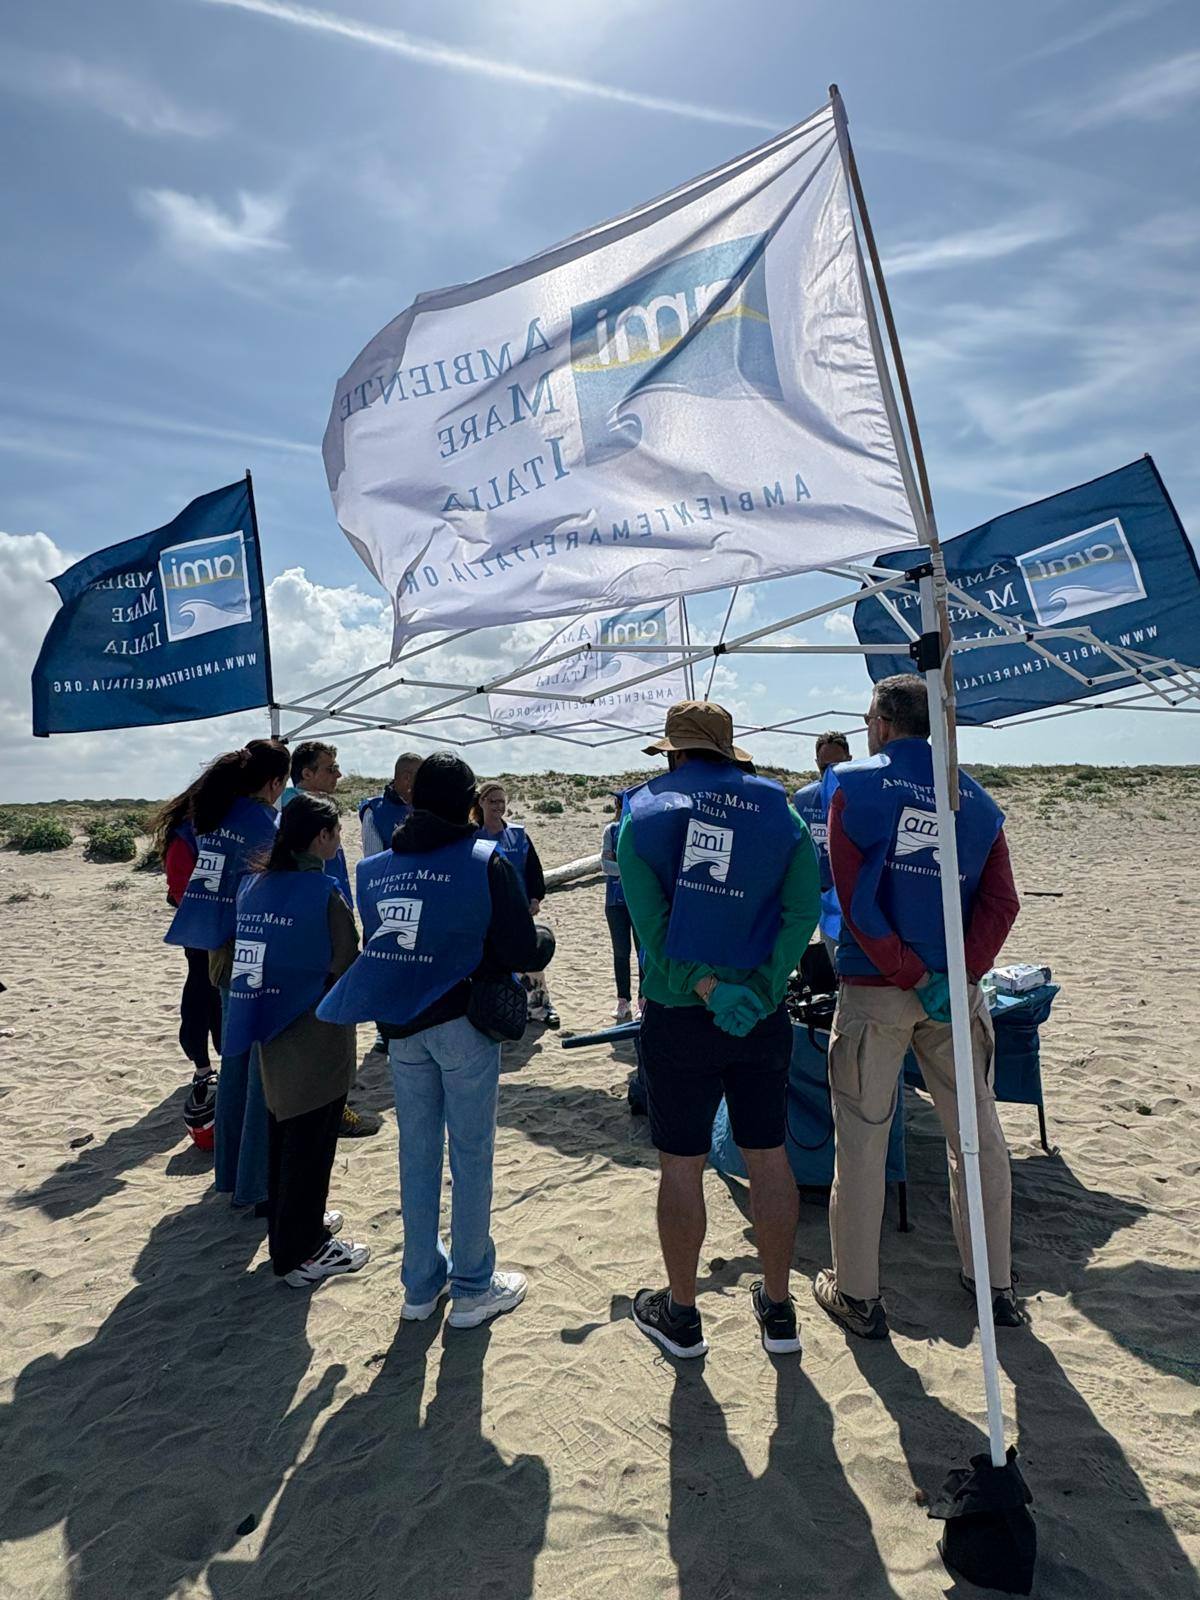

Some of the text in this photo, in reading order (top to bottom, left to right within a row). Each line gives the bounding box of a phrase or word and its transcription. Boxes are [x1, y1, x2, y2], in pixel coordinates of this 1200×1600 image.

[881, 778, 935, 794] AMBIENT
[696, 799, 727, 819] ITALIA
[723, 793, 760, 813] MARE
[904, 816, 939, 837] am
[415, 869, 452, 883] MARE
[383, 883, 418, 894] ITALIA
[262, 912, 294, 926] MARE
